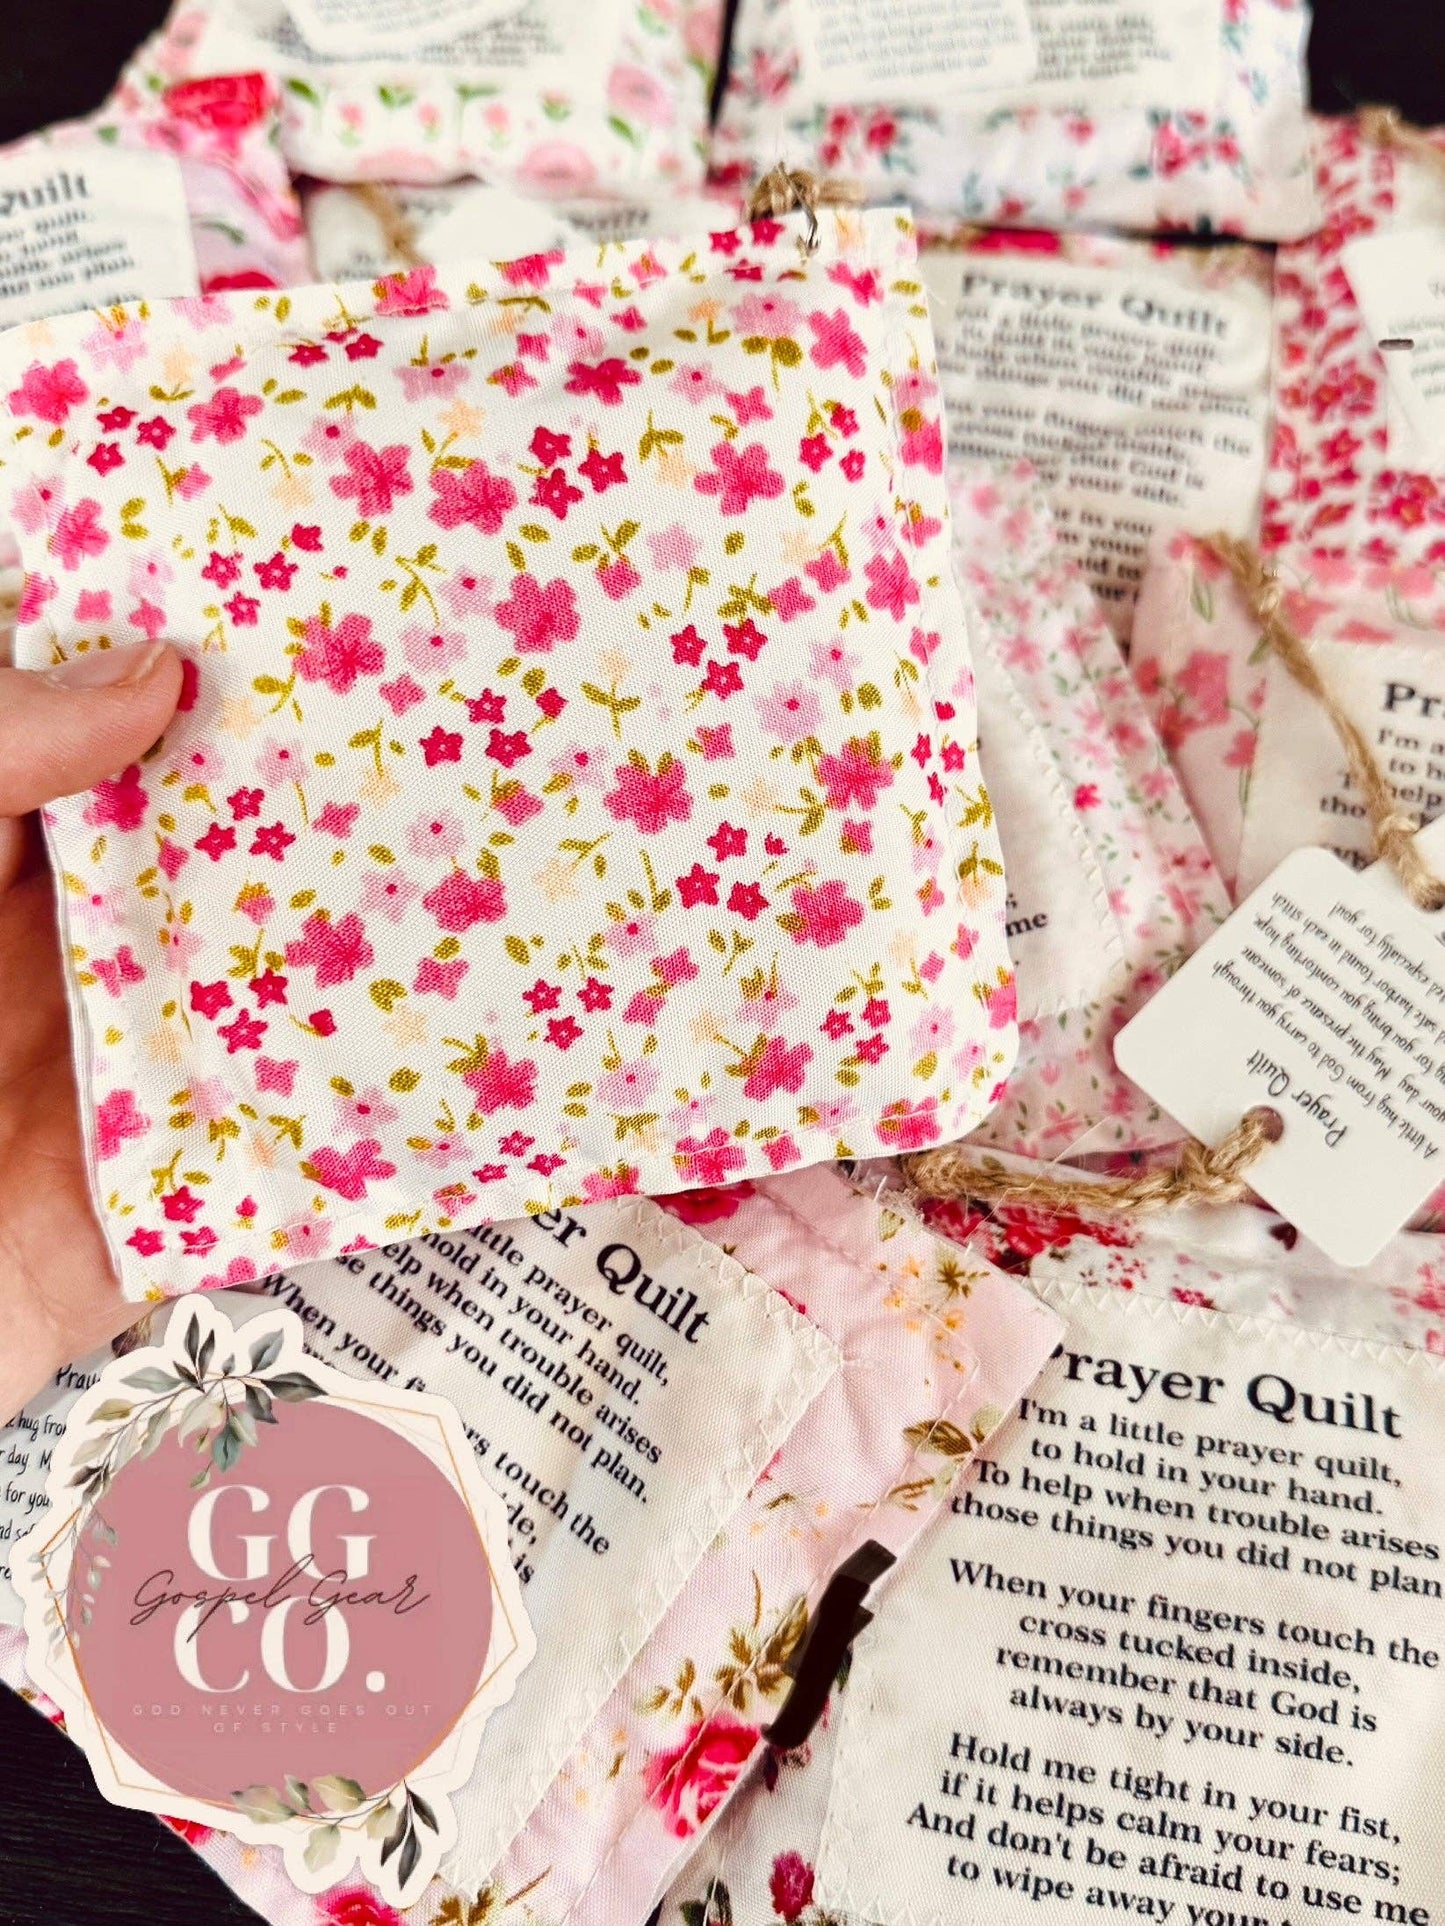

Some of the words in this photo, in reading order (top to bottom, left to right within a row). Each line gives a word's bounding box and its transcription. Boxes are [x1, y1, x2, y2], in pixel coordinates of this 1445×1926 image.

[1382, 680, 1445, 718] Pr
[1377, 727, 1420, 750] I'm
[1389, 756, 1416, 775] to
[1272, 891, 1304, 922] stitch
[1302, 918, 1330, 942] each
[1357, 925, 1378, 945] for
[1240, 946, 1288, 988] someone
[1280, 931, 1340, 997] comforting
[1339, 950, 1375, 984] found
[1377, 932, 1429, 983] especially
[1212, 960, 1258, 1004] through
[1288, 985, 1301, 1000] of
[1340, 988, 1368, 1008] you
[1375, 979, 1414, 1014] harbor
[1256, 997, 1281, 1019] you
[1300, 998, 1352, 1039] presence
[1360, 1001, 1393, 1039] bring
[1413, 1008, 1437, 1034] safe
[1276, 1010, 1307, 1046] carry
[1348, 1035, 1367, 1058] the
[1392, 1031, 1420, 1053] you
[1309, 1041, 1322, 1057] to
[1317, 1053, 1344, 1082] God
[1366, 1046, 1392, 1082] May
[1412, 1051, 1434, 1073] for
[1247, 1049, 1291, 1097] Quilt
[1346, 1074, 1376, 1106] from
[1292, 1089, 1348, 1148] Prayer
[1376, 1095, 1400, 1129] hug
[1398, 1121, 1425, 1152] little
[1424, 1144, 1438, 1159] A
[596, 1243, 710, 1344] Quilt
[479, 1267, 509, 1299] in
[509, 1296, 573, 1345] your
[576, 1338, 642, 1405] hand.
[523, 1265, 612, 1332] prayer
[616, 1333, 668, 1386] quilt,
[335, 1332, 399, 1381] your
[381, 1243, 422, 1276] elp
[427, 1272, 495, 1332] when
[500, 1327, 593, 1406] trouble
[596, 1404, 662, 1464] arises
[369, 1271, 447, 1337] things
[446, 1333, 498, 1378] you
[502, 1372, 549, 1415] did
[549, 1410, 593, 1452] not
[591, 1447, 647, 1504] plan.
[1051, 1343, 1225, 1404] rayer
[1247, 1373, 1402, 1439] Quilt
[18, 1408, 39, 1441] hug
[44, 1414, 66, 1436] fro
[1018, 1398, 1067, 1427] I'm
[1079, 1416, 1096, 1432] a
[1109, 1412, 1184, 1447] little
[1195, 1434, 1304, 1466] prayer
[1315, 1455, 1401, 1488] quilt,
[8, 1445, 28, 1475] day
[1032, 1438, 1062, 1460] to
[1074, 1441, 1145, 1476] hold
[1157, 1457, 1188, 1484] in
[1199, 1469, 1276, 1497] your
[1287, 1477, 1383, 1515] hand.
[6, 1481, 26, 1503] for
[494, 1451, 569, 1520] touch
[570, 1512, 610, 1555] the
[973, 1458, 1010, 1487] To
[1021, 1466, 1093, 1506] help
[1105, 1487, 1195, 1520] when
[1208, 1503, 1330, 1540] trouble
[1341, 1528, 1440, 1560] arises
[951, 1491, 1039, 1527] those
[1051, 1510, 1154, 1550] things
[1164, 1534, 1224, 1560] you
[1236, 1541, 1290, 1571] did
[1303, 1555, 1357, 1581] not
[1370, 1565, 1442, 1599] plan
[950, 1558, 1046, 1599] When
[1058, 1584, 1135, 1614] your
[1147, 1594, 1265, 1635] fingers
[1277, 1619, 1375, 1656] touch
[1388, 1637, 1439, 1669] the
[1019, 1615, 1107, 1646] cross
[1119, 1630, 1235, 1669] tucked
[1248, 1649, 1360, 1694] inside,
[996, 1647, 1177, 1695] remember
[1188, 1677, 1257, 1710] that
[1271, 1690, 1339, 1725] God
[1351, 1706, 1377, 1732] is
[1009, 1684, 1123, 1727] always
[1136, 1703, 1174, 1738] by
[1184, 1719, 1264, 1749] your
[1275, 1733, 1353, 1767] side.
[950, 1732, 1031, 1773] Hold
[1043, 1757, 1096, 1784] me
[1110, 1766, 1190, 1801] tight
[1204, 1781, 1237, 1810] in
[1249, 1796, 1328, 1826] your
[1339, 1806, 1401, 1845] fist,
[941, 1770, 969, 1797] if
[975, 1778, 999, 1806] it
[1011, 1784, 1104, 1827] helps
[1116, 1811, 1202, 1845] calm
[1214, 1829, 1295, 1860] your
[1305, 1840, 1401, 1886] fears;
[906, 1802, 976, 1841] And
[987, 1821, 1072, 1860] don't
[1086, 1838, 1127, 1870] be
[1139, 1852, 1243, 1893] afraid
[1256, 1874, 1290, 1900] to
[1302, 1885, 1363, 1915] use
[1374, 1899, 1430, 1926] me
[948, 1854, 980, 1881] to
[993, 1867, 1075, 1902] wipe
[1086, 1886, 1175, 1925] away
